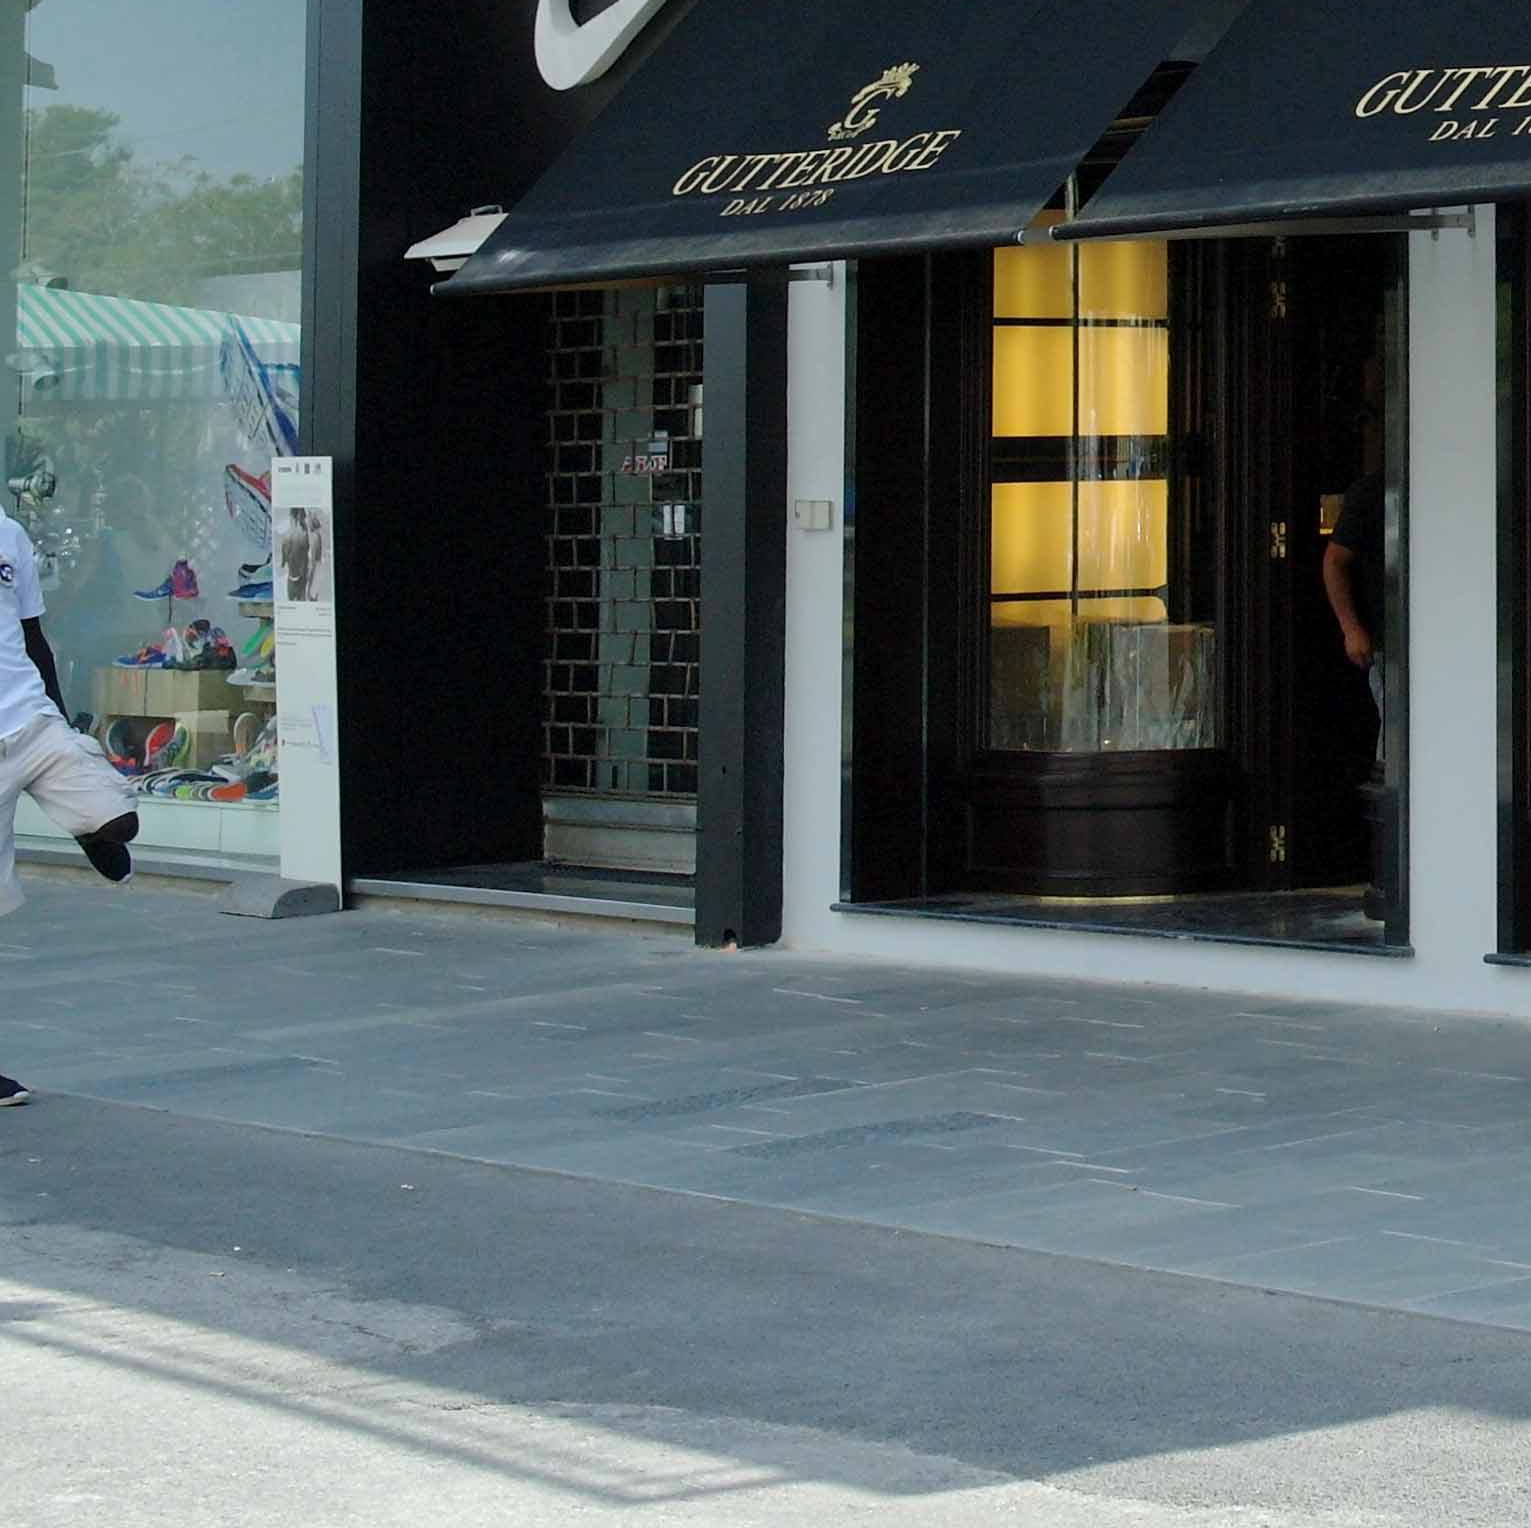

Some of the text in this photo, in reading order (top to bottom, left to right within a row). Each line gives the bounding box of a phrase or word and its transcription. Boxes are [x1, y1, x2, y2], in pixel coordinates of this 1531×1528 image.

[1428, 119, 1500, 141] DAL
[672, 129, 962, 196] GUTTERIDGE
[720, 187, 835, 217] DAL 1878
